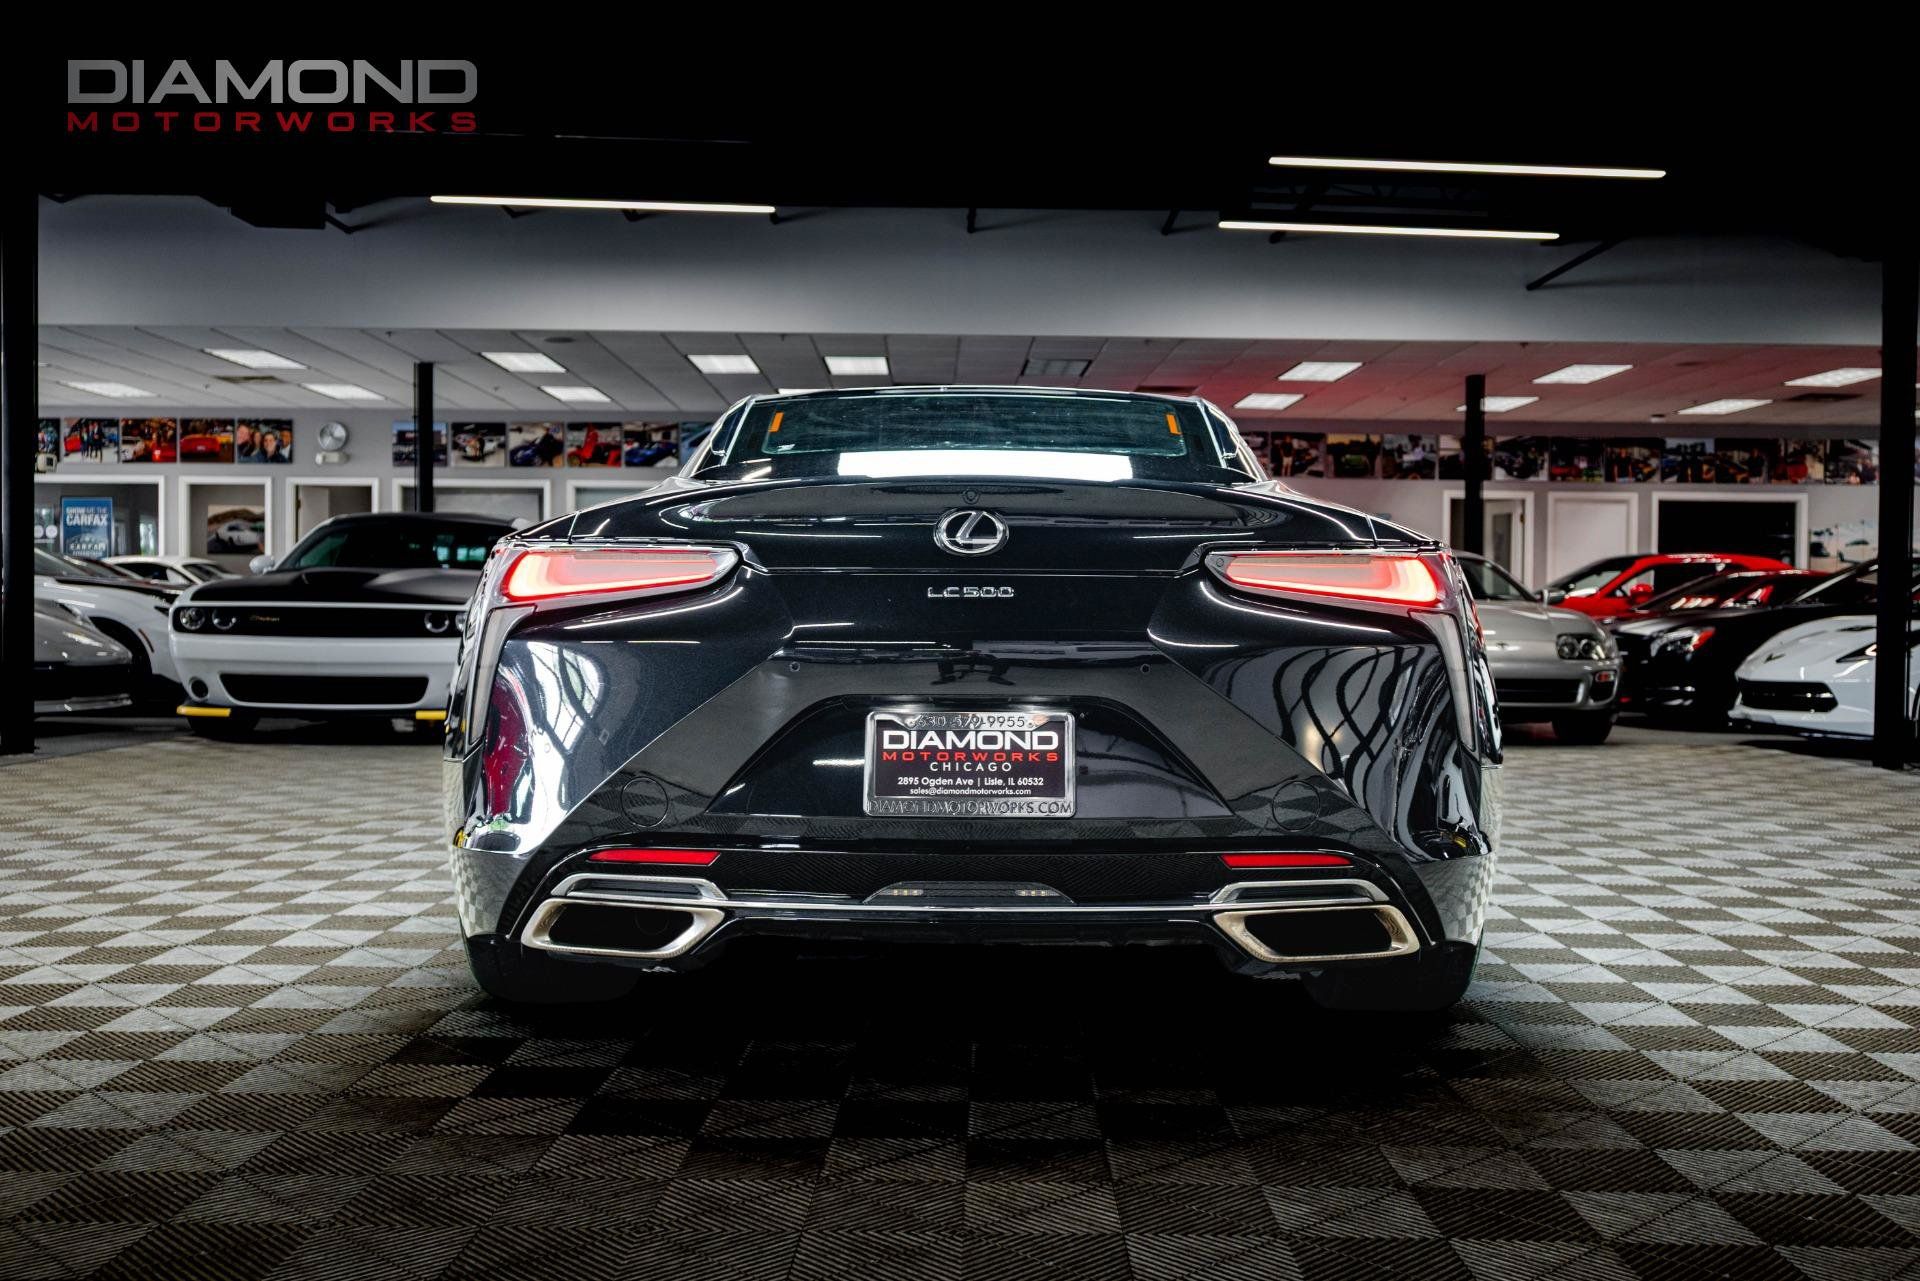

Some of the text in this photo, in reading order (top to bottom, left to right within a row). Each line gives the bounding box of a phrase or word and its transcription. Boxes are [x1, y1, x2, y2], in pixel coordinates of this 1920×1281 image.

[66, 513, 109, 527] CARFAX
[882, 730, 1059, 750] DIAMOND
[882, 751, 1059, 762] MOTORWORKS
[929, 761, 1012, 772] CHICAGO
[897, 776, 919, 786] 2895
[921, 776, 953, 788] Ogden
[955, 776, 974, 786] Ave
[984, 776, 1005, 787] Lisle,
[1008, 777, 1015, 786] IL
[1017, 776, 1044, 786] 60532
[909, 787, 1032, 796] sales@diamondmotorworks.com
[869, 800, 1072, 815] DIAMONDMOTORWORKS.COM
